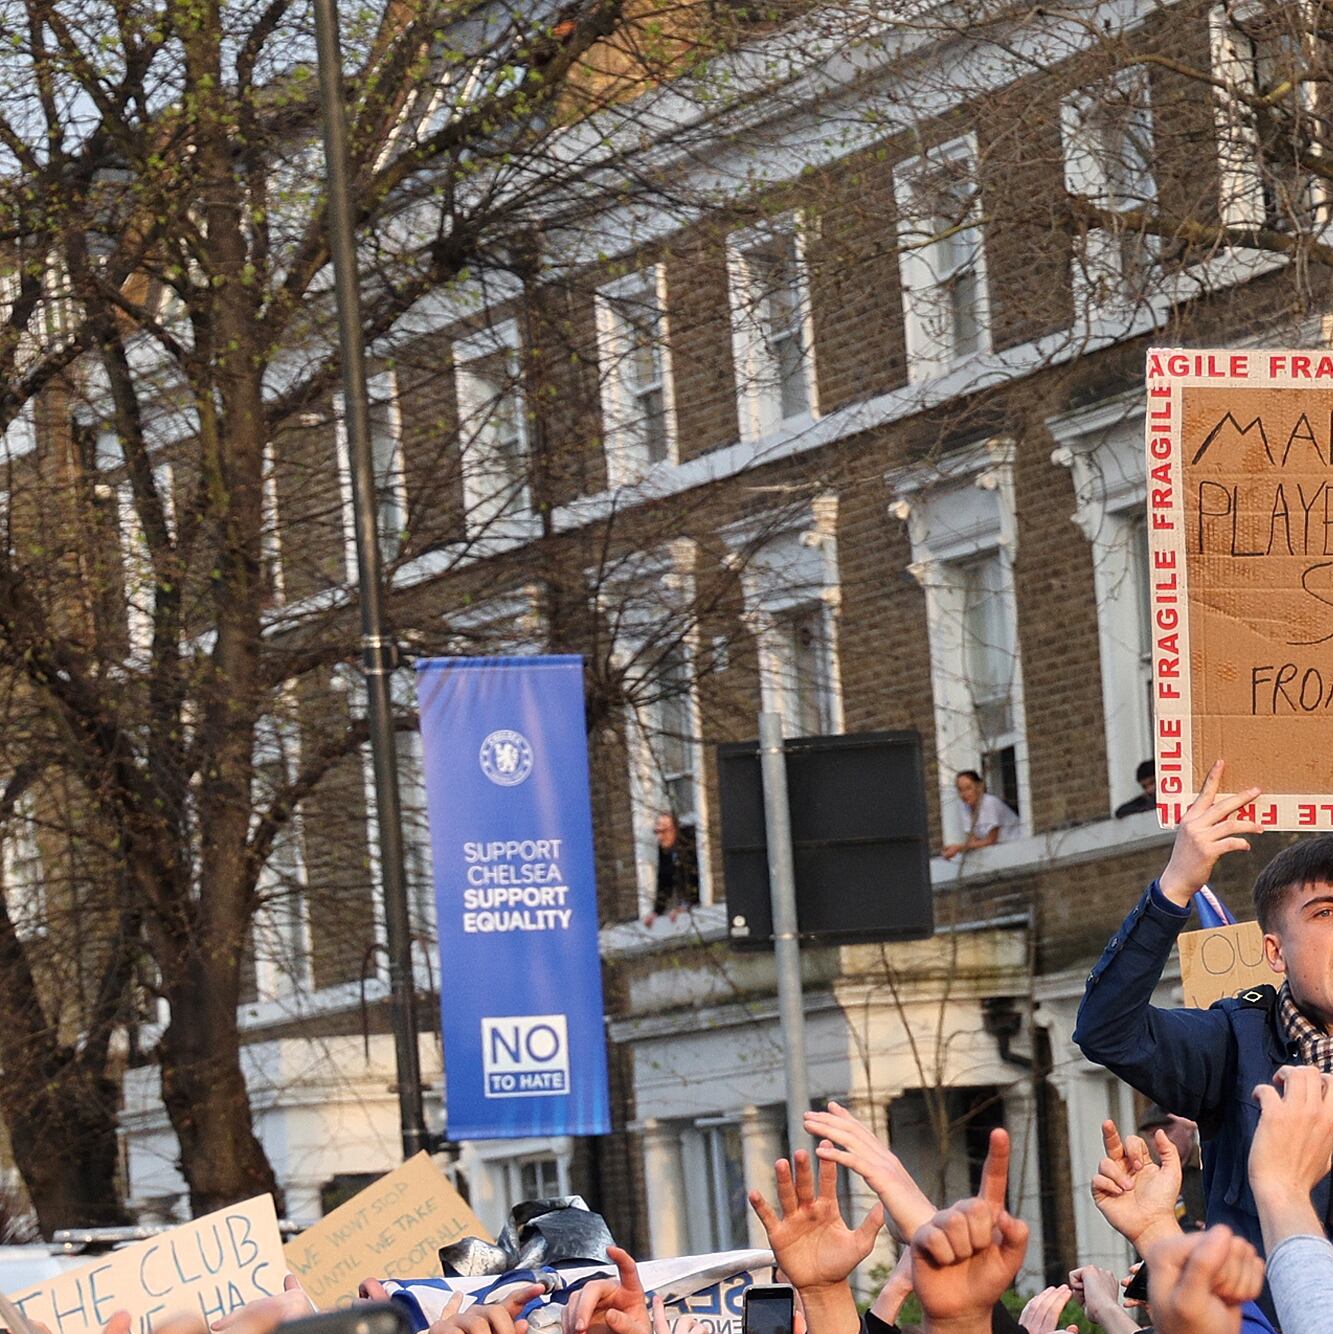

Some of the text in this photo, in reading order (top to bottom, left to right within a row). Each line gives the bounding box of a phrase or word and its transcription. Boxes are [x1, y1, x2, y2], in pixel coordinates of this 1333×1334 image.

[1151, 385, 1174, 530] FRAGILE
[1154, 550, 1180, 699] FRAGILE
[464, 840, 562, 863] SUPPORT
[467, 864, 562, 886] CHELSEA
[464, 886, 570, 910] SUPPORT
[463, 909, 572, 933] EQUALITY
[491, 1025, 560, 1064] NO
[491, 1072, 563, 1091] TO HATE
[371, 1182, 409, 1214] STOP
[366, 1227, 397, 1255] WE
[392, 1197, 439, 1233] TAKE
[140, 1214, 259, 1297] CLUB
